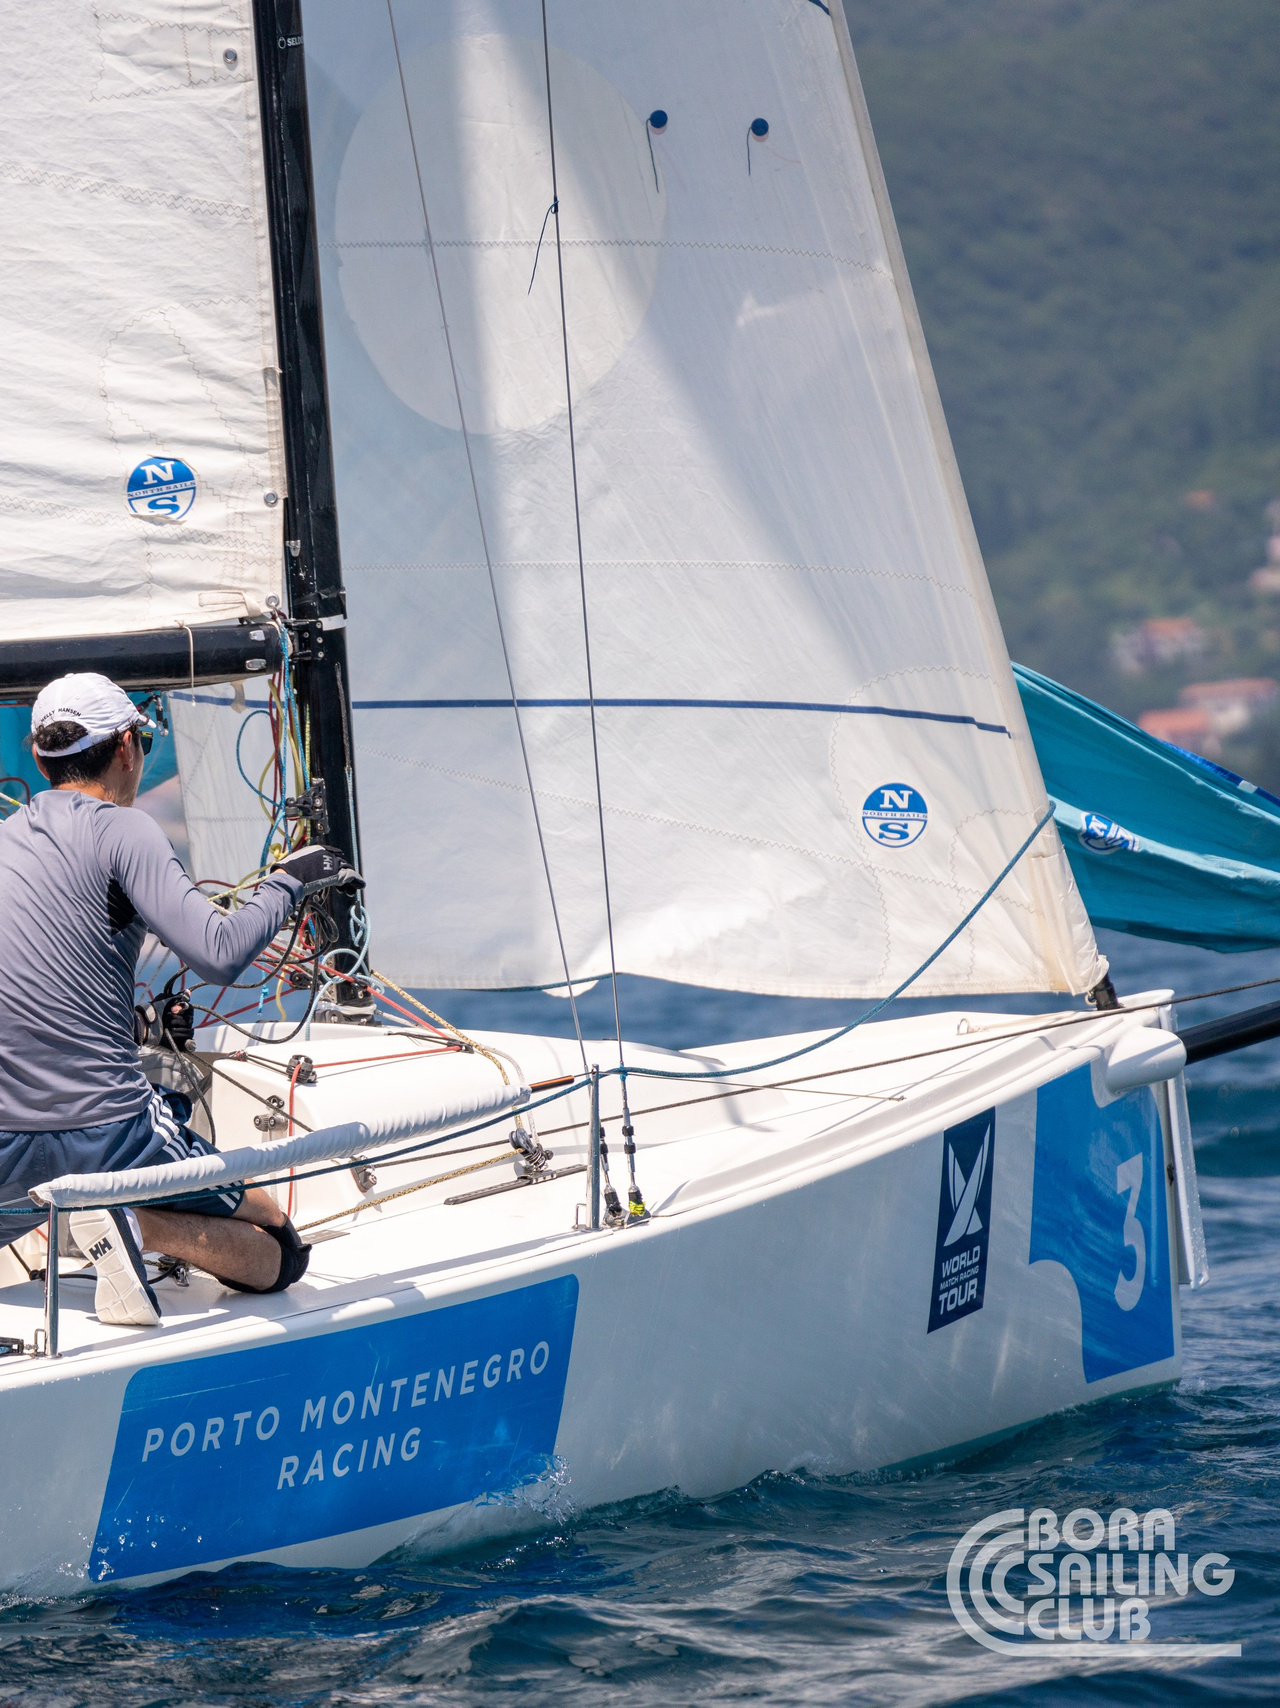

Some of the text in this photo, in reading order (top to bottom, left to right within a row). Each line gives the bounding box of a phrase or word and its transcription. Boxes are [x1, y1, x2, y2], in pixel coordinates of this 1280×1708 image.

[140, 460, 175, 485] N
[128, 480, 196, 497] NORTH SAILS
[147, 495, 180, 516] S
[40, 707, 81, 722] HELLY HANSEN
[880, 789, 913, 809] N
[879, 822, 910, 841] S
[323, 854, 333, 871] HH
[1114, 1152, 1146, 1311] 3
[88, 1237, 113, 1261] HH
[942, 1245, 980, 1278] WORLD
[940, 1265, 979, 1291] MATCH RACING
[939, 1278, 978, 1315] TOUR
[141, 1341, 550, 1462] PORTO MONTENEGRO
[276, 1427, 421, 1490] RACING
